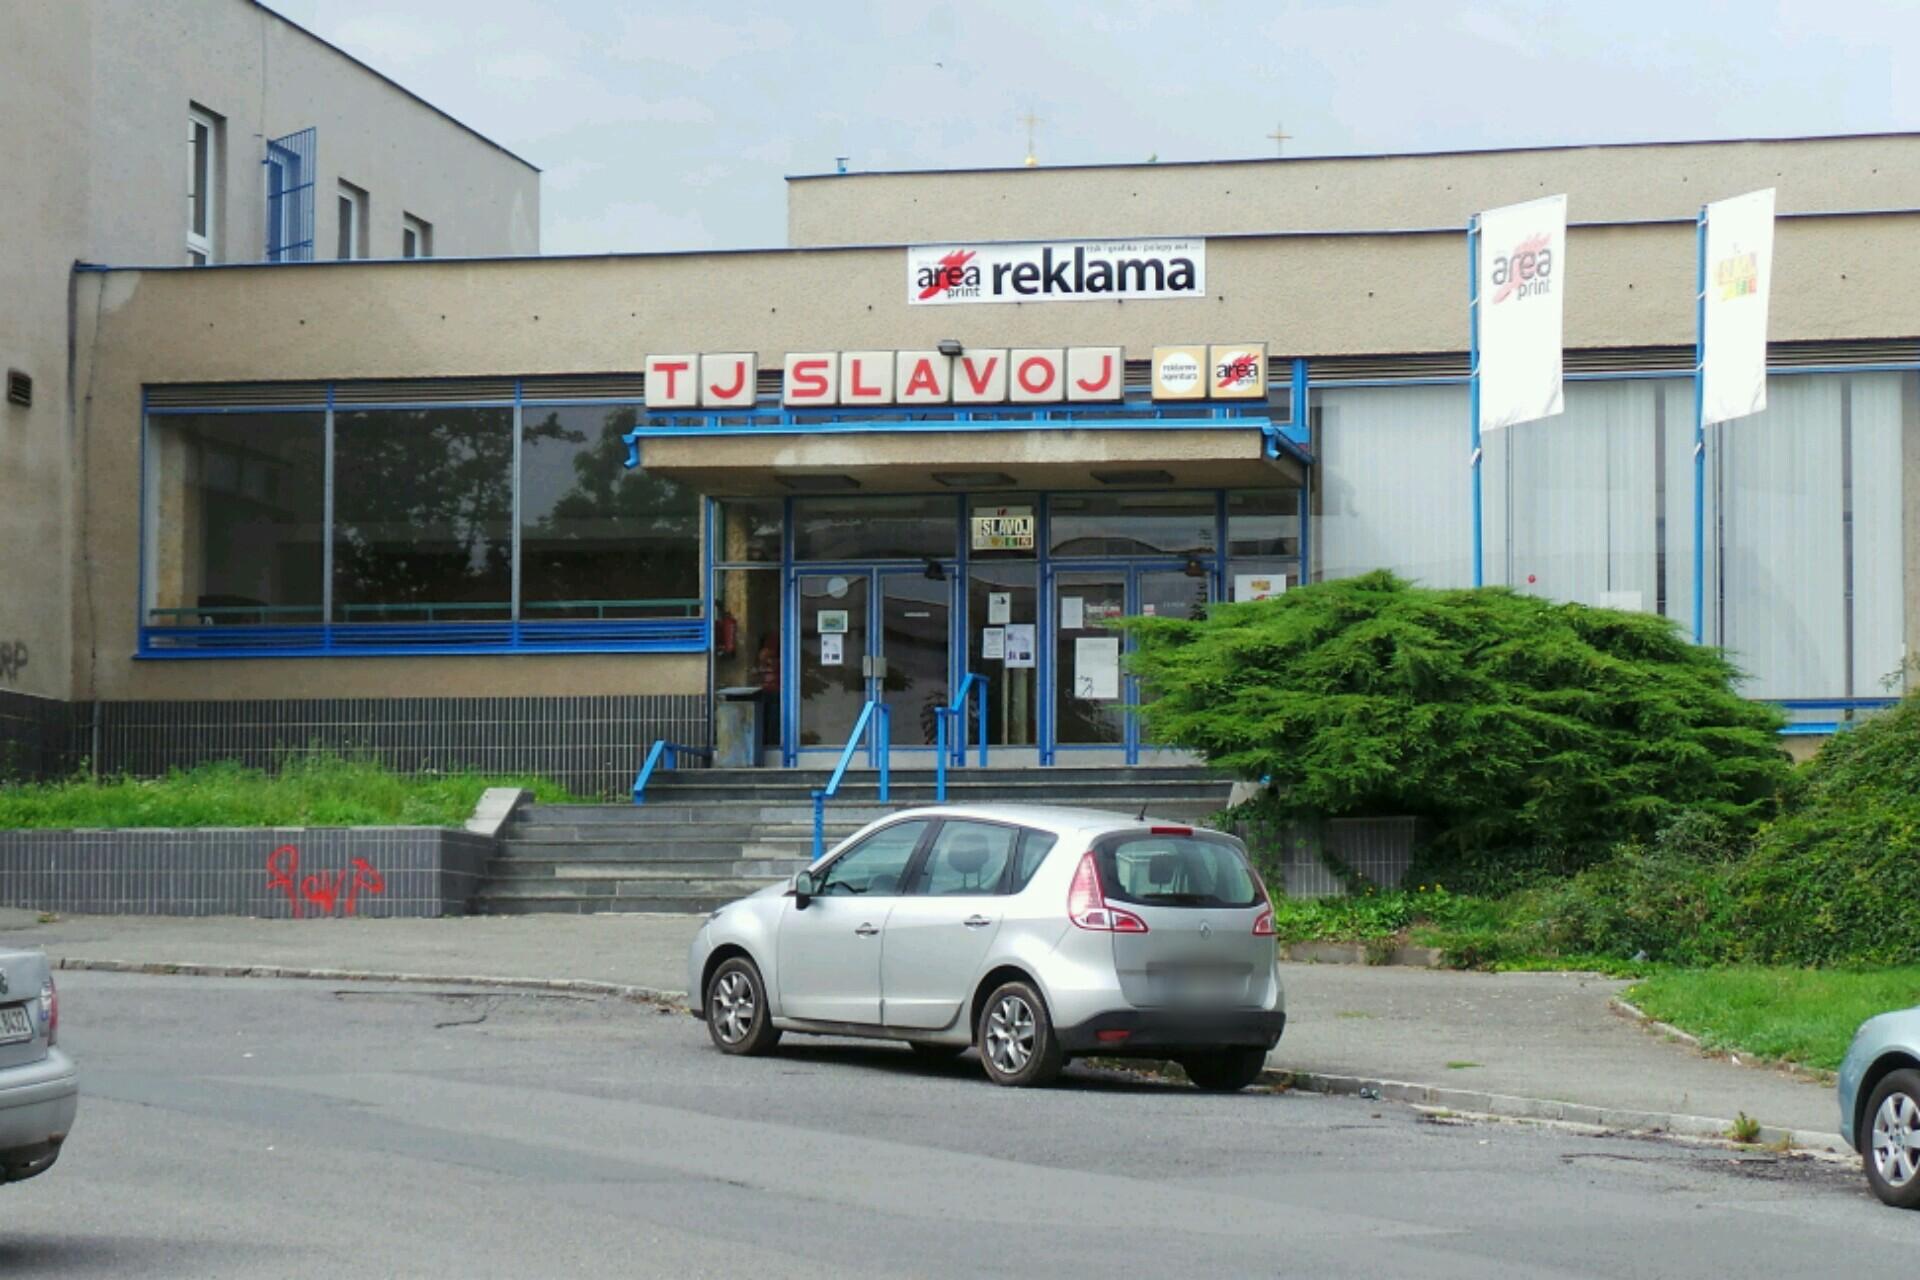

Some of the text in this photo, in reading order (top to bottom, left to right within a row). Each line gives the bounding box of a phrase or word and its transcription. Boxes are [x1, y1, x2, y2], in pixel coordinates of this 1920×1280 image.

[918, 264, 980, 288] area
[992, 246, 1195, 294] reklama
[1492, 248, 1552, 286] area
[947, 284, 980, 299] print
[1517, 278, 1551, 301] print
[653, 355, 1113, 400] TJ SLAVOJ
[1215, 362, 1259, 378] area
[981, 518, 1030, 537] SLAVOJ
